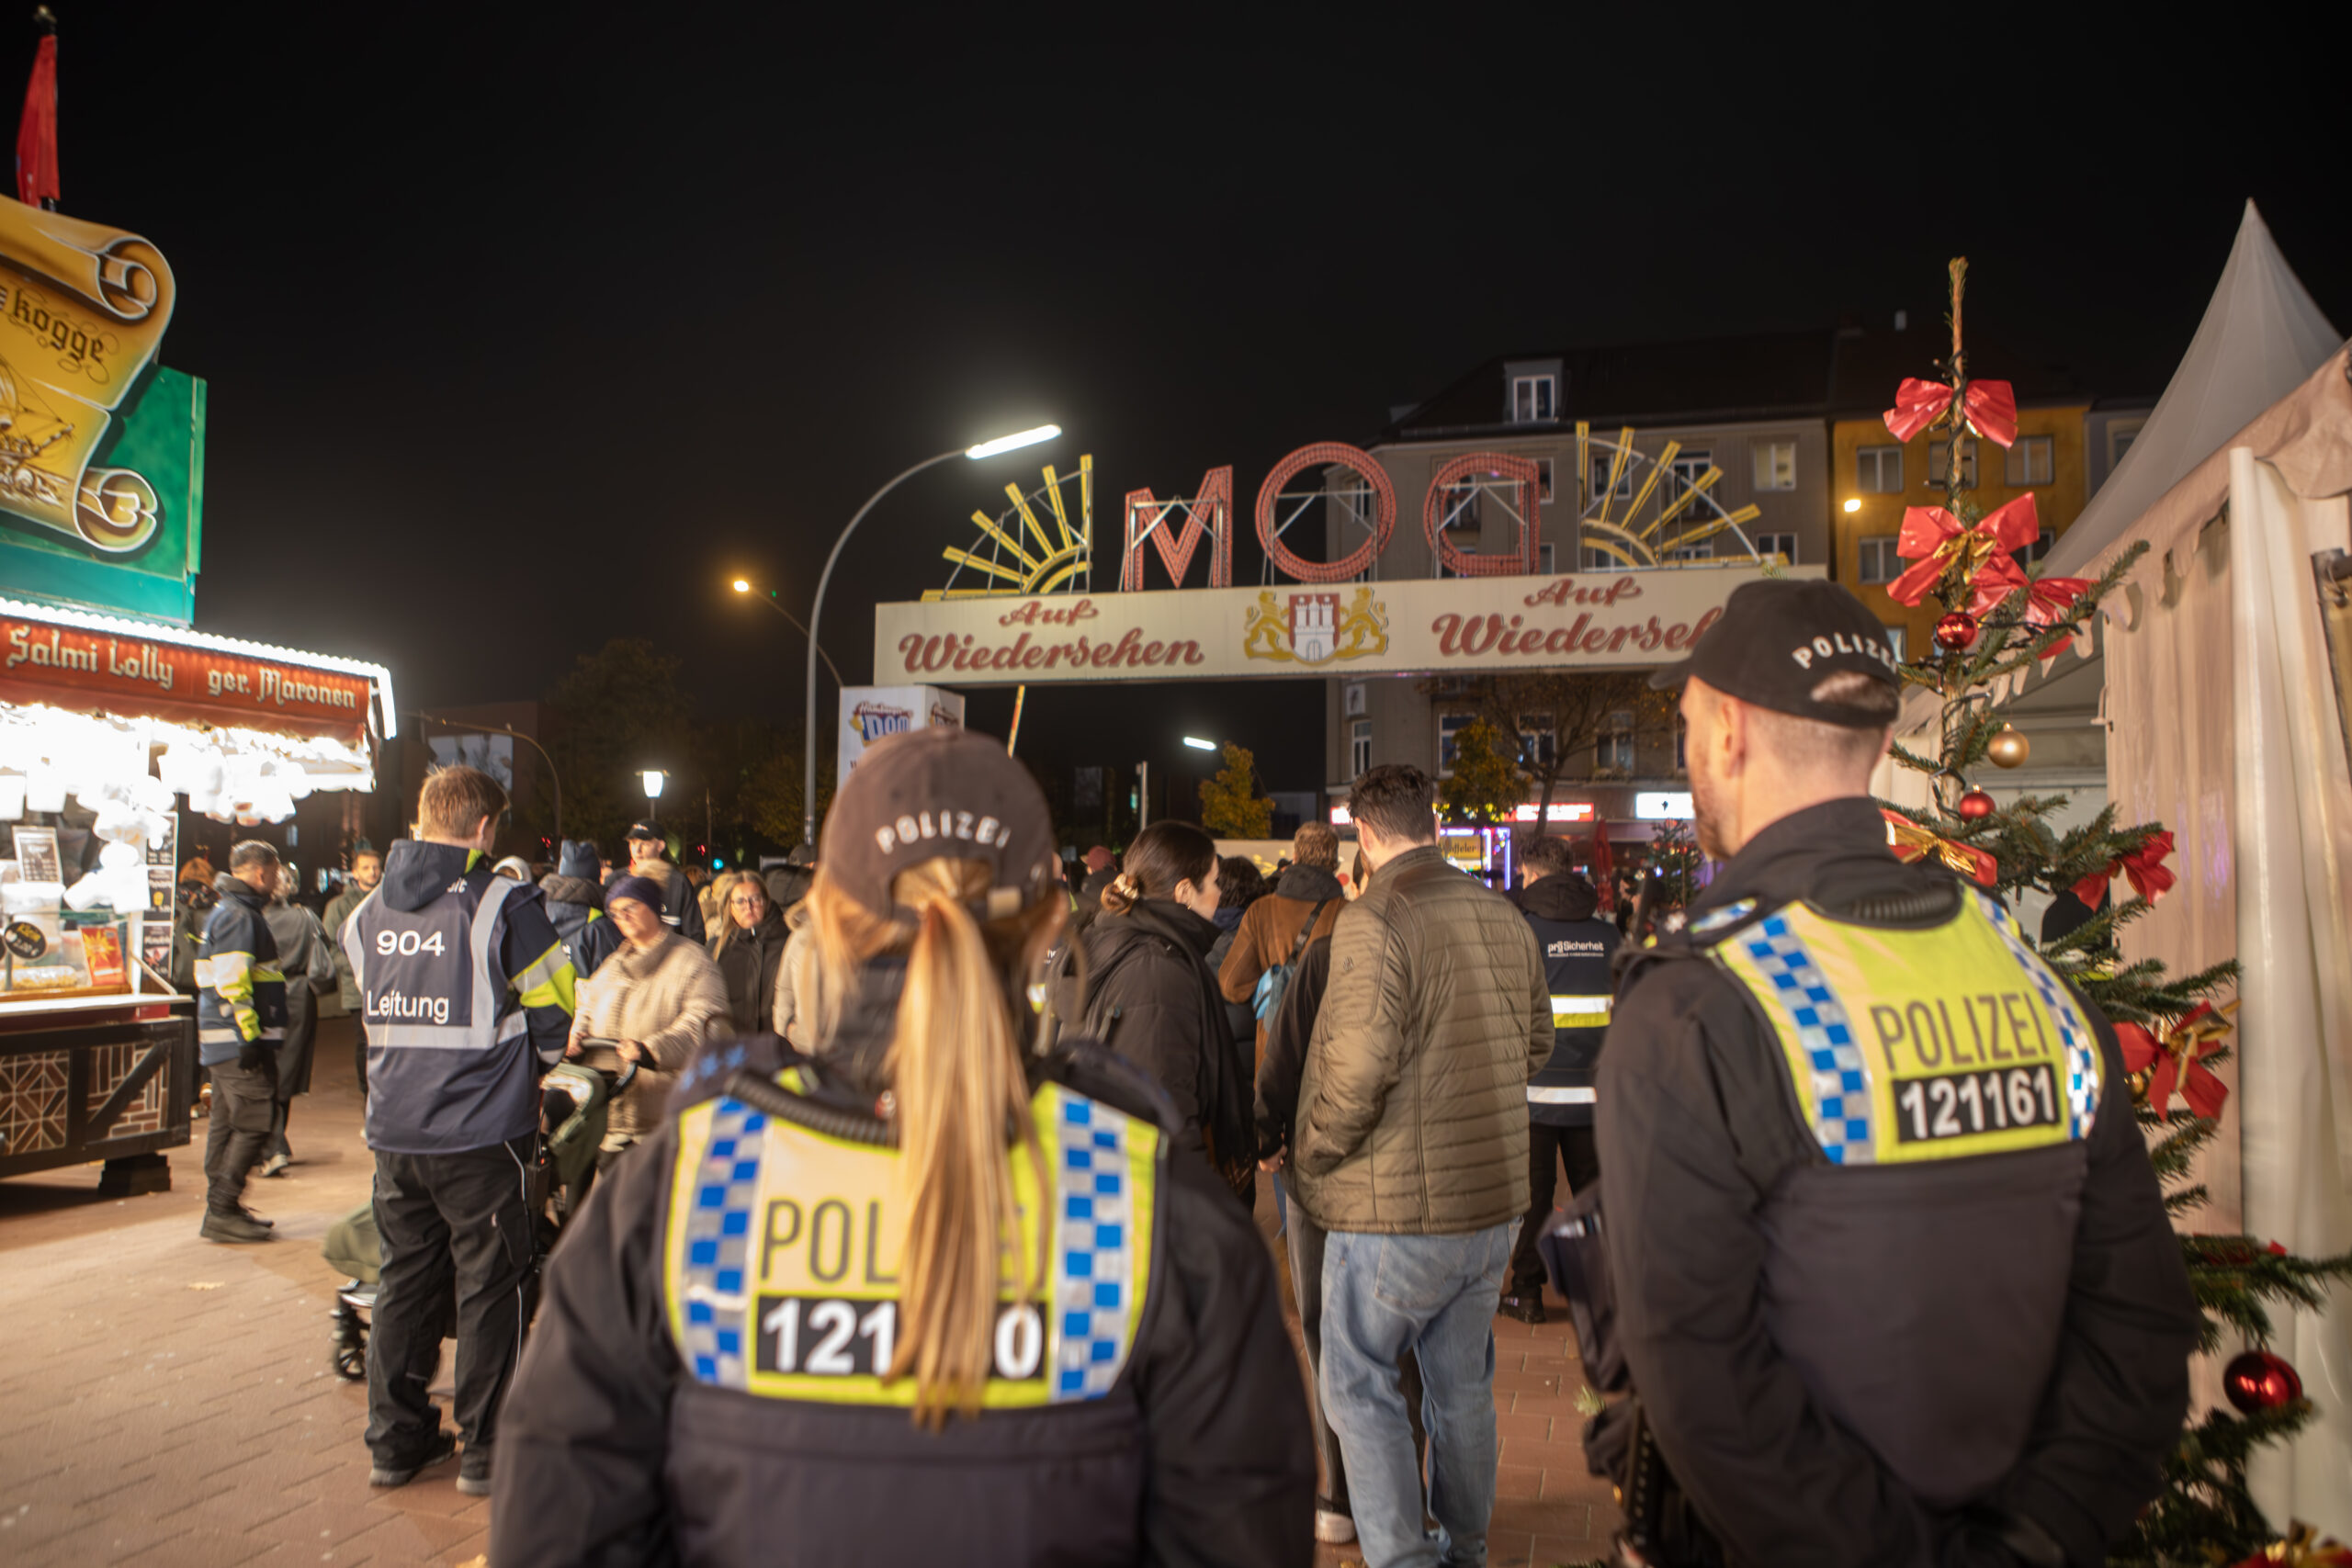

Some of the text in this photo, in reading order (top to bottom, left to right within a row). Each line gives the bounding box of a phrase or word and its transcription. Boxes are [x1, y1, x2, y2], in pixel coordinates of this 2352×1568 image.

[999, 599, 1099, 626] Auf
[1523, 576, 1643, 607] Auf
[6, 625, 174, 691] Salmi Lolly
[899, 627, 1205, 673] Wiedersehen
[208, 666, 356, 709] ger. Maronen
[876, 809, 1012, 855] POLIZEI
[377, 930, 446, 957] 904
[368, 989, 449, 1025] Leitung
[1869, 990, 2050, 1073] POLIZEI
[1901, 1066, 2055, 1140] 121161
[763, 1297, 1044, 1380] 1210
